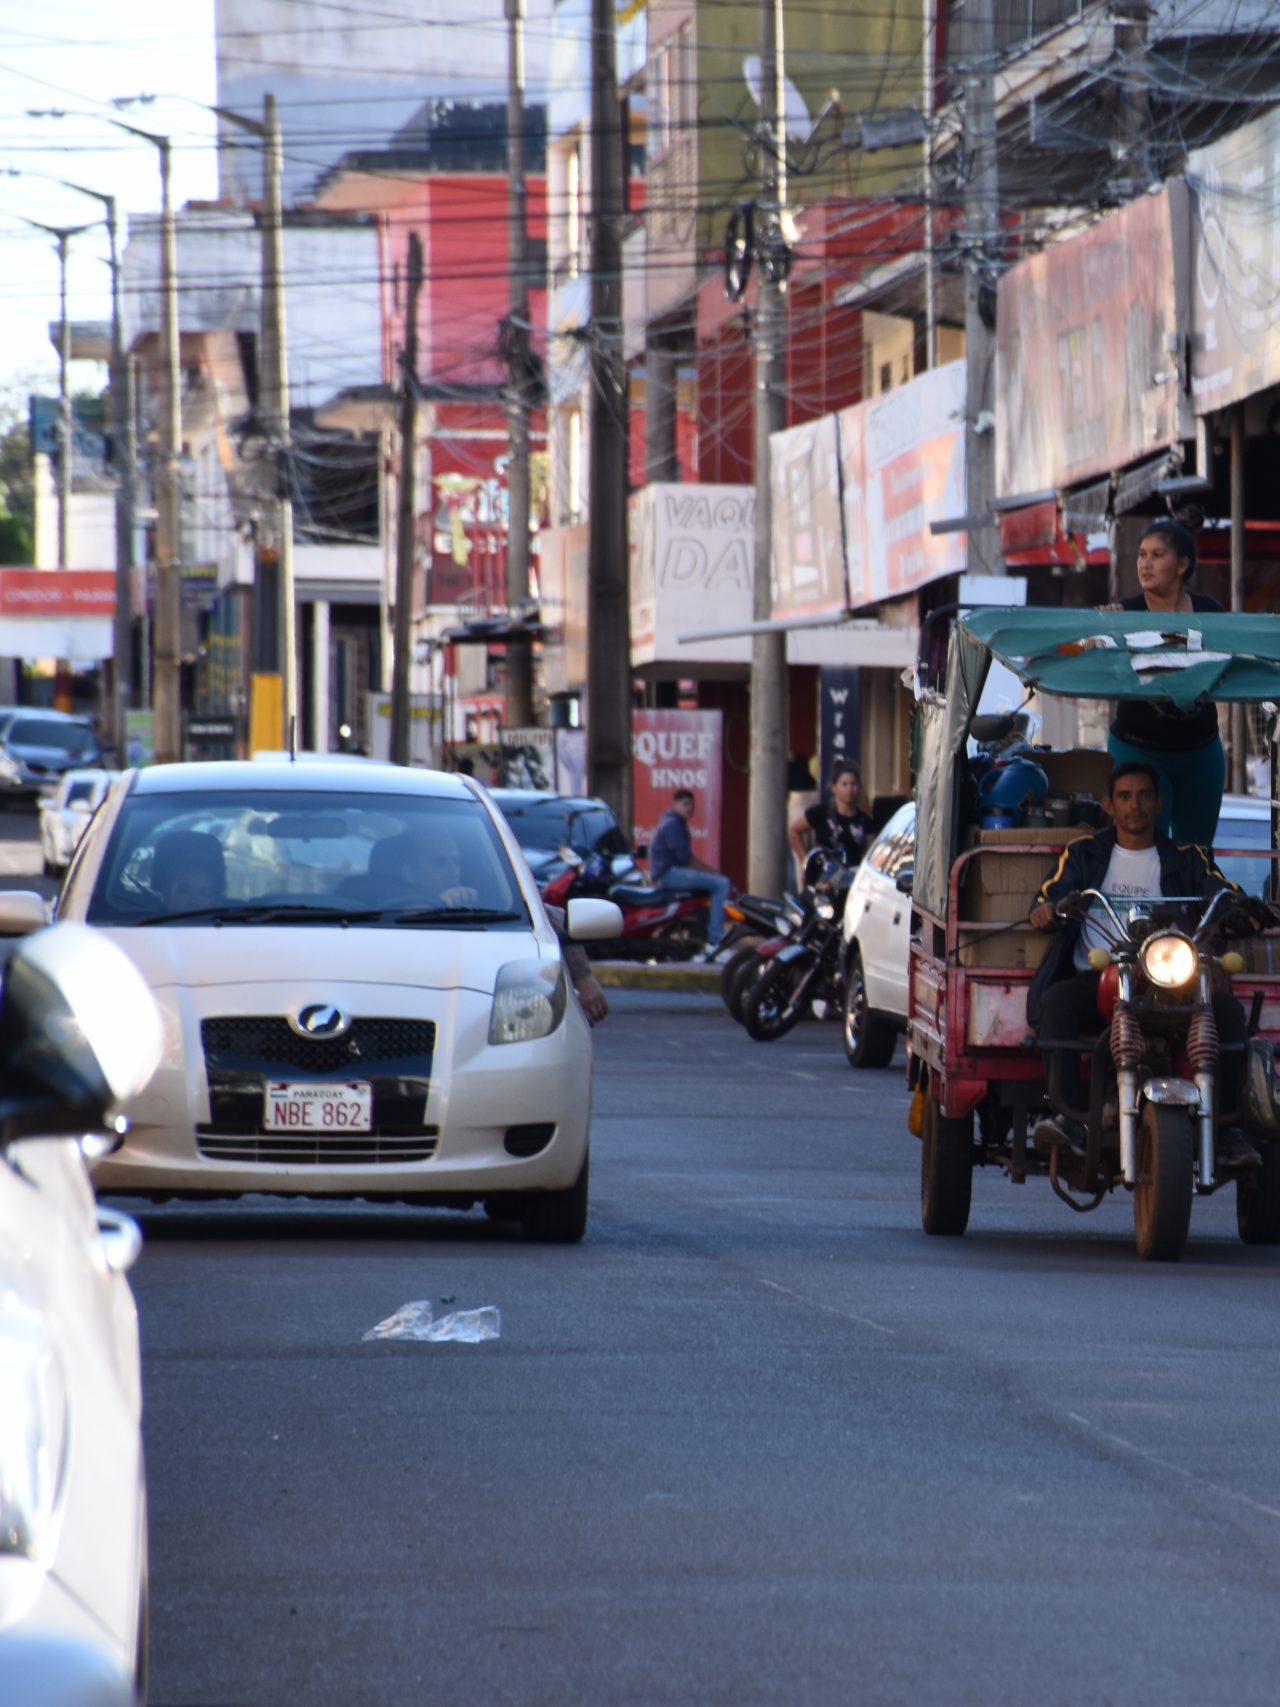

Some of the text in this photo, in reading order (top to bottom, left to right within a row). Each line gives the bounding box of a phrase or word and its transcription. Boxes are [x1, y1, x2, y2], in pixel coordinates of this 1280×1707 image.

[650, 767, 708, 789] HNOS
[293, 1089, 344, 1099] PARAGUAY
[274, 1101, 362, 1127] NBE 862
